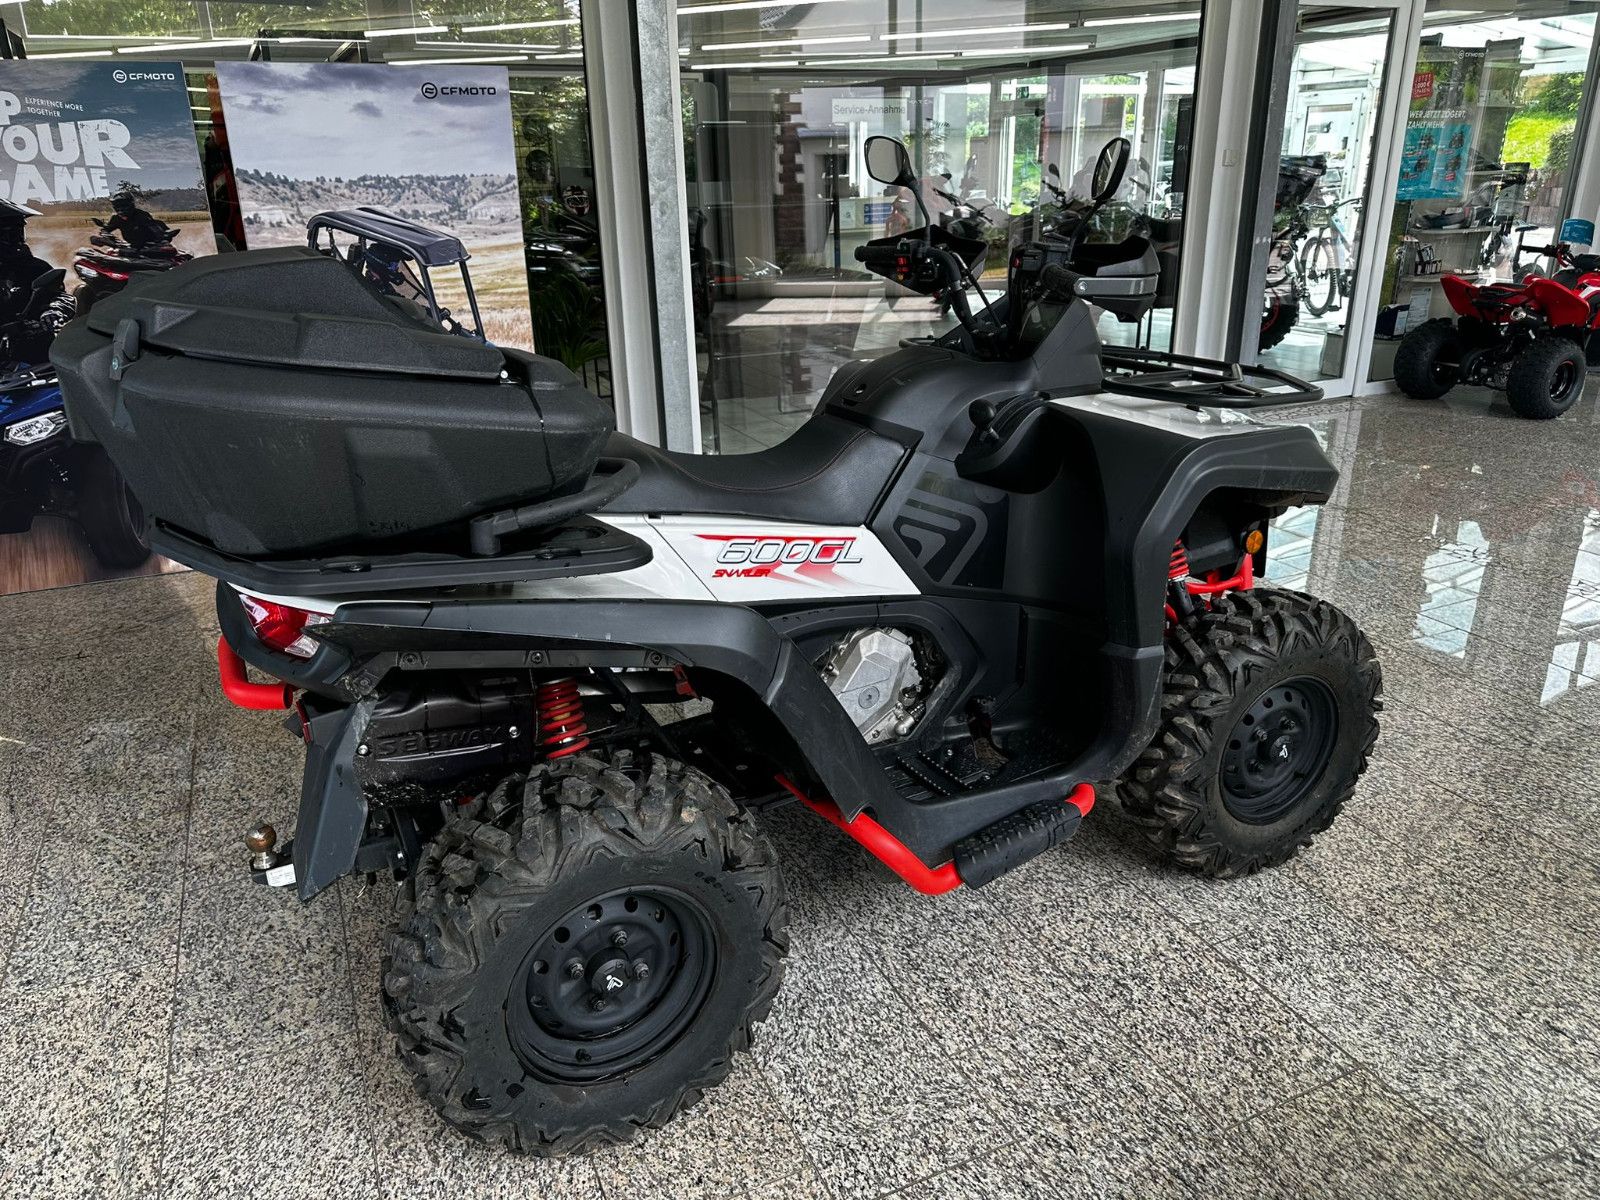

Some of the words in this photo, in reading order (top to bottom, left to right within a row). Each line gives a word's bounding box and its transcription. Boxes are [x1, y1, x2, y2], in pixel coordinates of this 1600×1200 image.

[441, 87, 497, 95] CFMOTO
[25, 97, 63, 109] EXPERIENCE
[65, 103, 84, 112] MORE
[833, 105, 906, 115] Service-Annahme
[27, 106, 61, 118] TOGETHER
[1410, 110, 1423, 118] WER
[0, 119, 141, 169] OUR
[716, 538, 863, 565] 600GL
[712, 568, 771, 578] SNARLER
